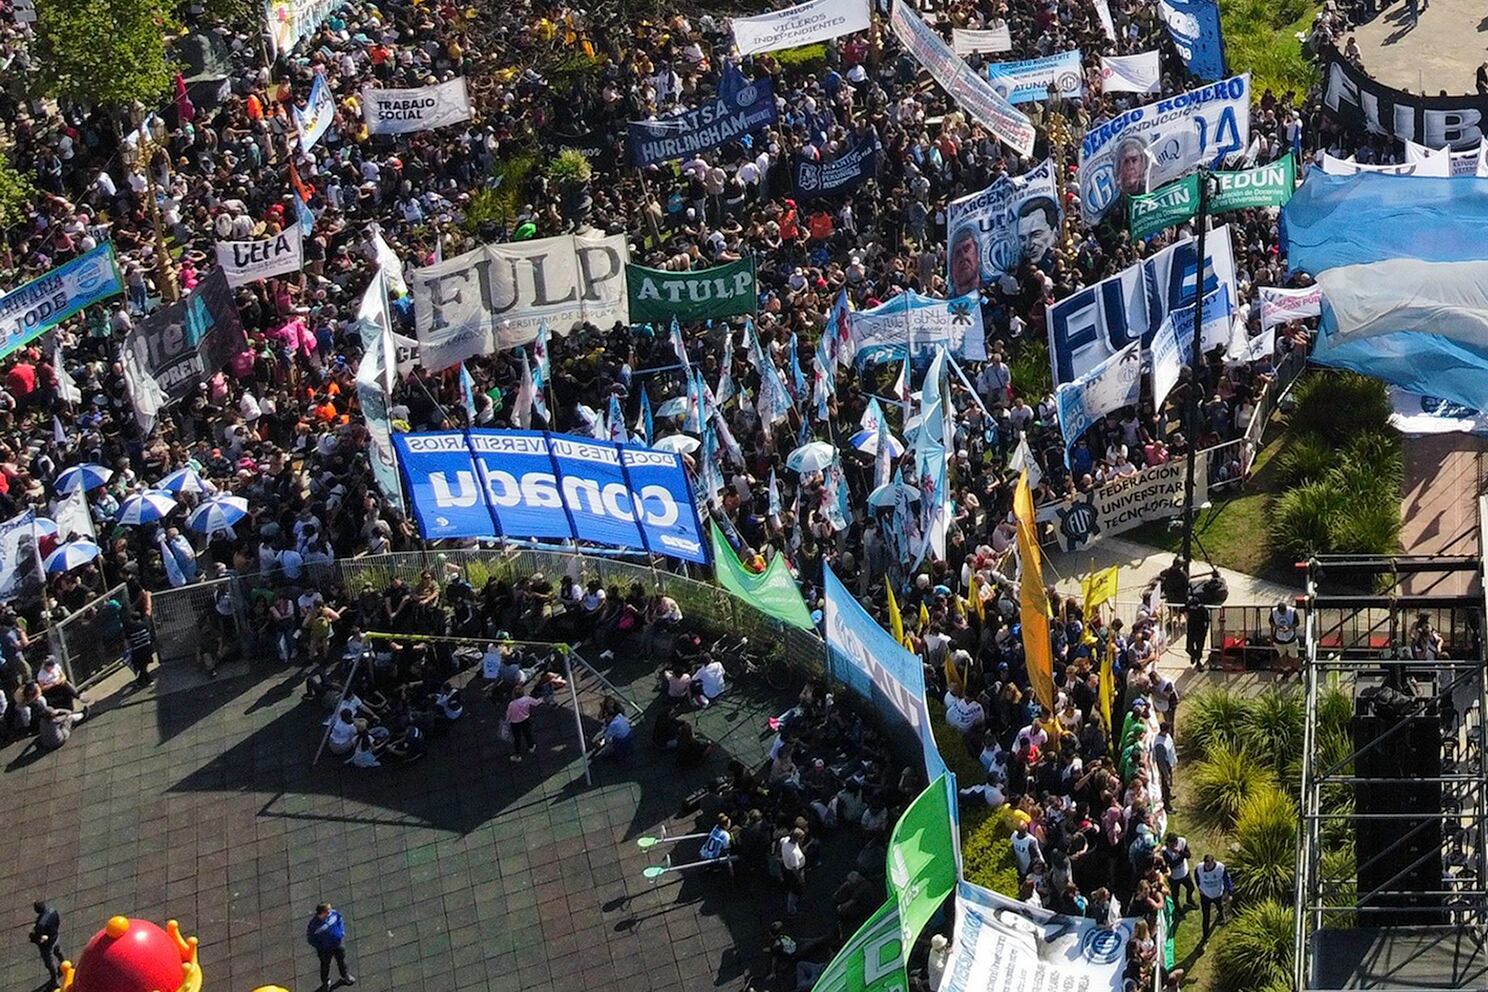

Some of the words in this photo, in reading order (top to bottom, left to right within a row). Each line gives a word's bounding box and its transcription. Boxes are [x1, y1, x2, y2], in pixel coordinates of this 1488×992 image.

[753, 15, 847, 46] INDEPENDIENTES
[772, 12, 827, 34] VILLEROS
[376, 97, 436, 112] TRABAJO
[378, 109, 423, 121] SOCIAL
[677, 99, 729, 134] ATSA
[1082, 108, 1145, 159] SERGIO
[1157, 77, 1245, 114] ROMERO
[641, 111, 748, 162] HURLINGHAM
[233, 234, 292, 268] CEFA
[424, 244, 621, 334] FULP
[635, 270, 754, 305] ATULP
[1099, 466, 1180, 501] FEDERACION
[1103, 497, 1185, 529] TECNOLOGIC
